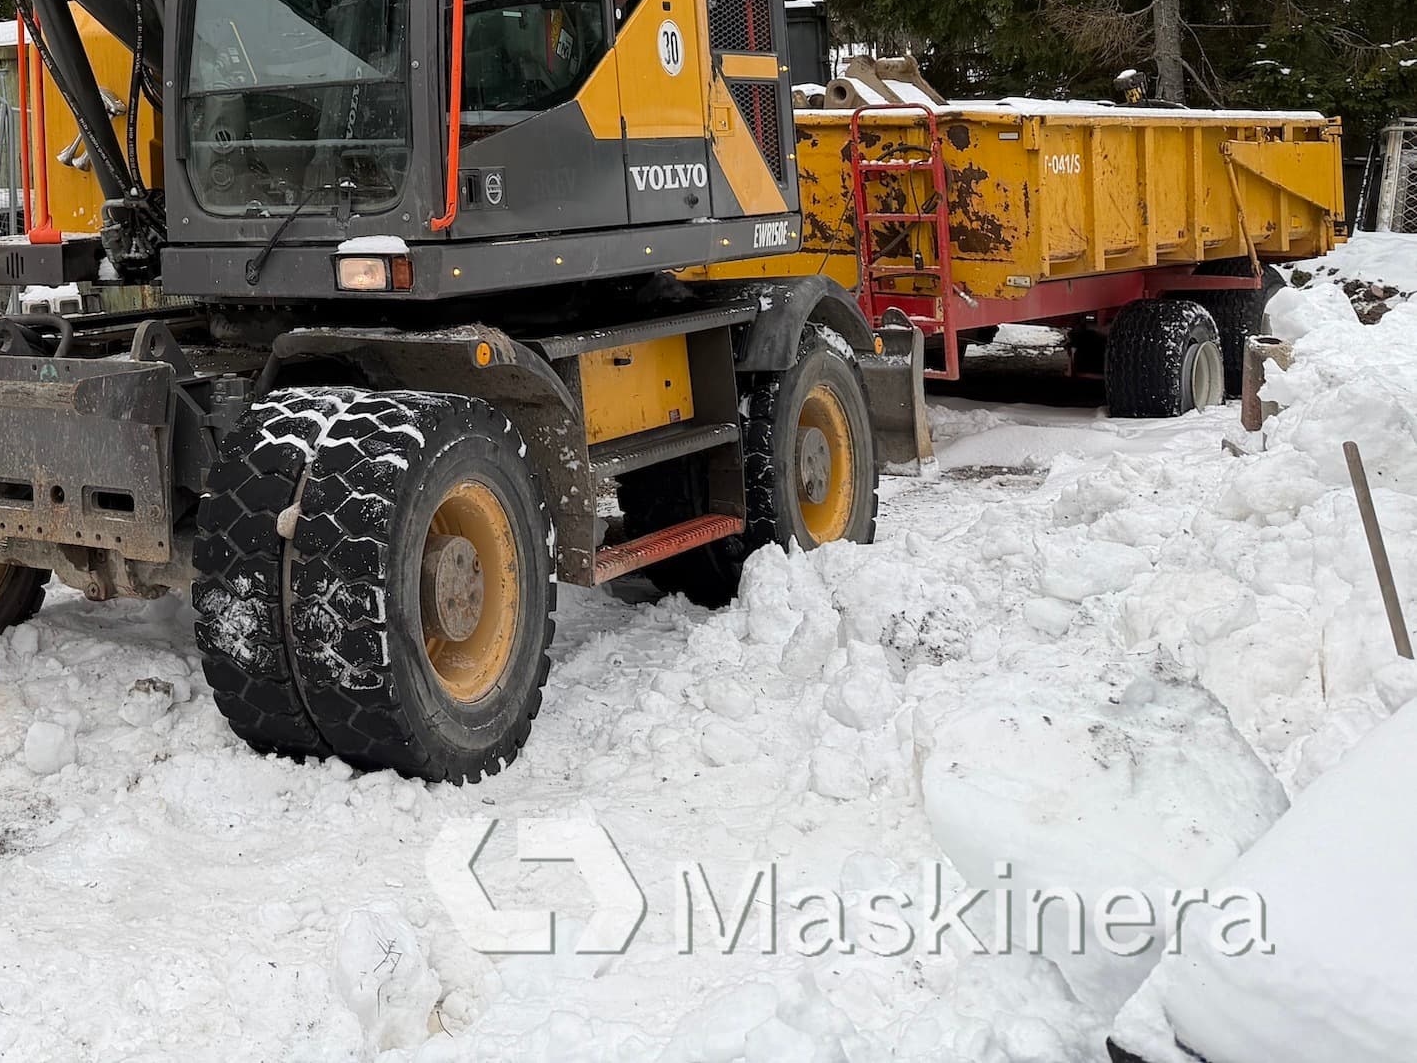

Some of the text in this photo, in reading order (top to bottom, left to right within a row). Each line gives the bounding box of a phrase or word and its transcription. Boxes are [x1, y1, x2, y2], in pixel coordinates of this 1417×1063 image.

[662, 30, 679, 65] 30
[629, 163, 708, 191] VOLVO
[753, 221, 789, 248] EWR150E
